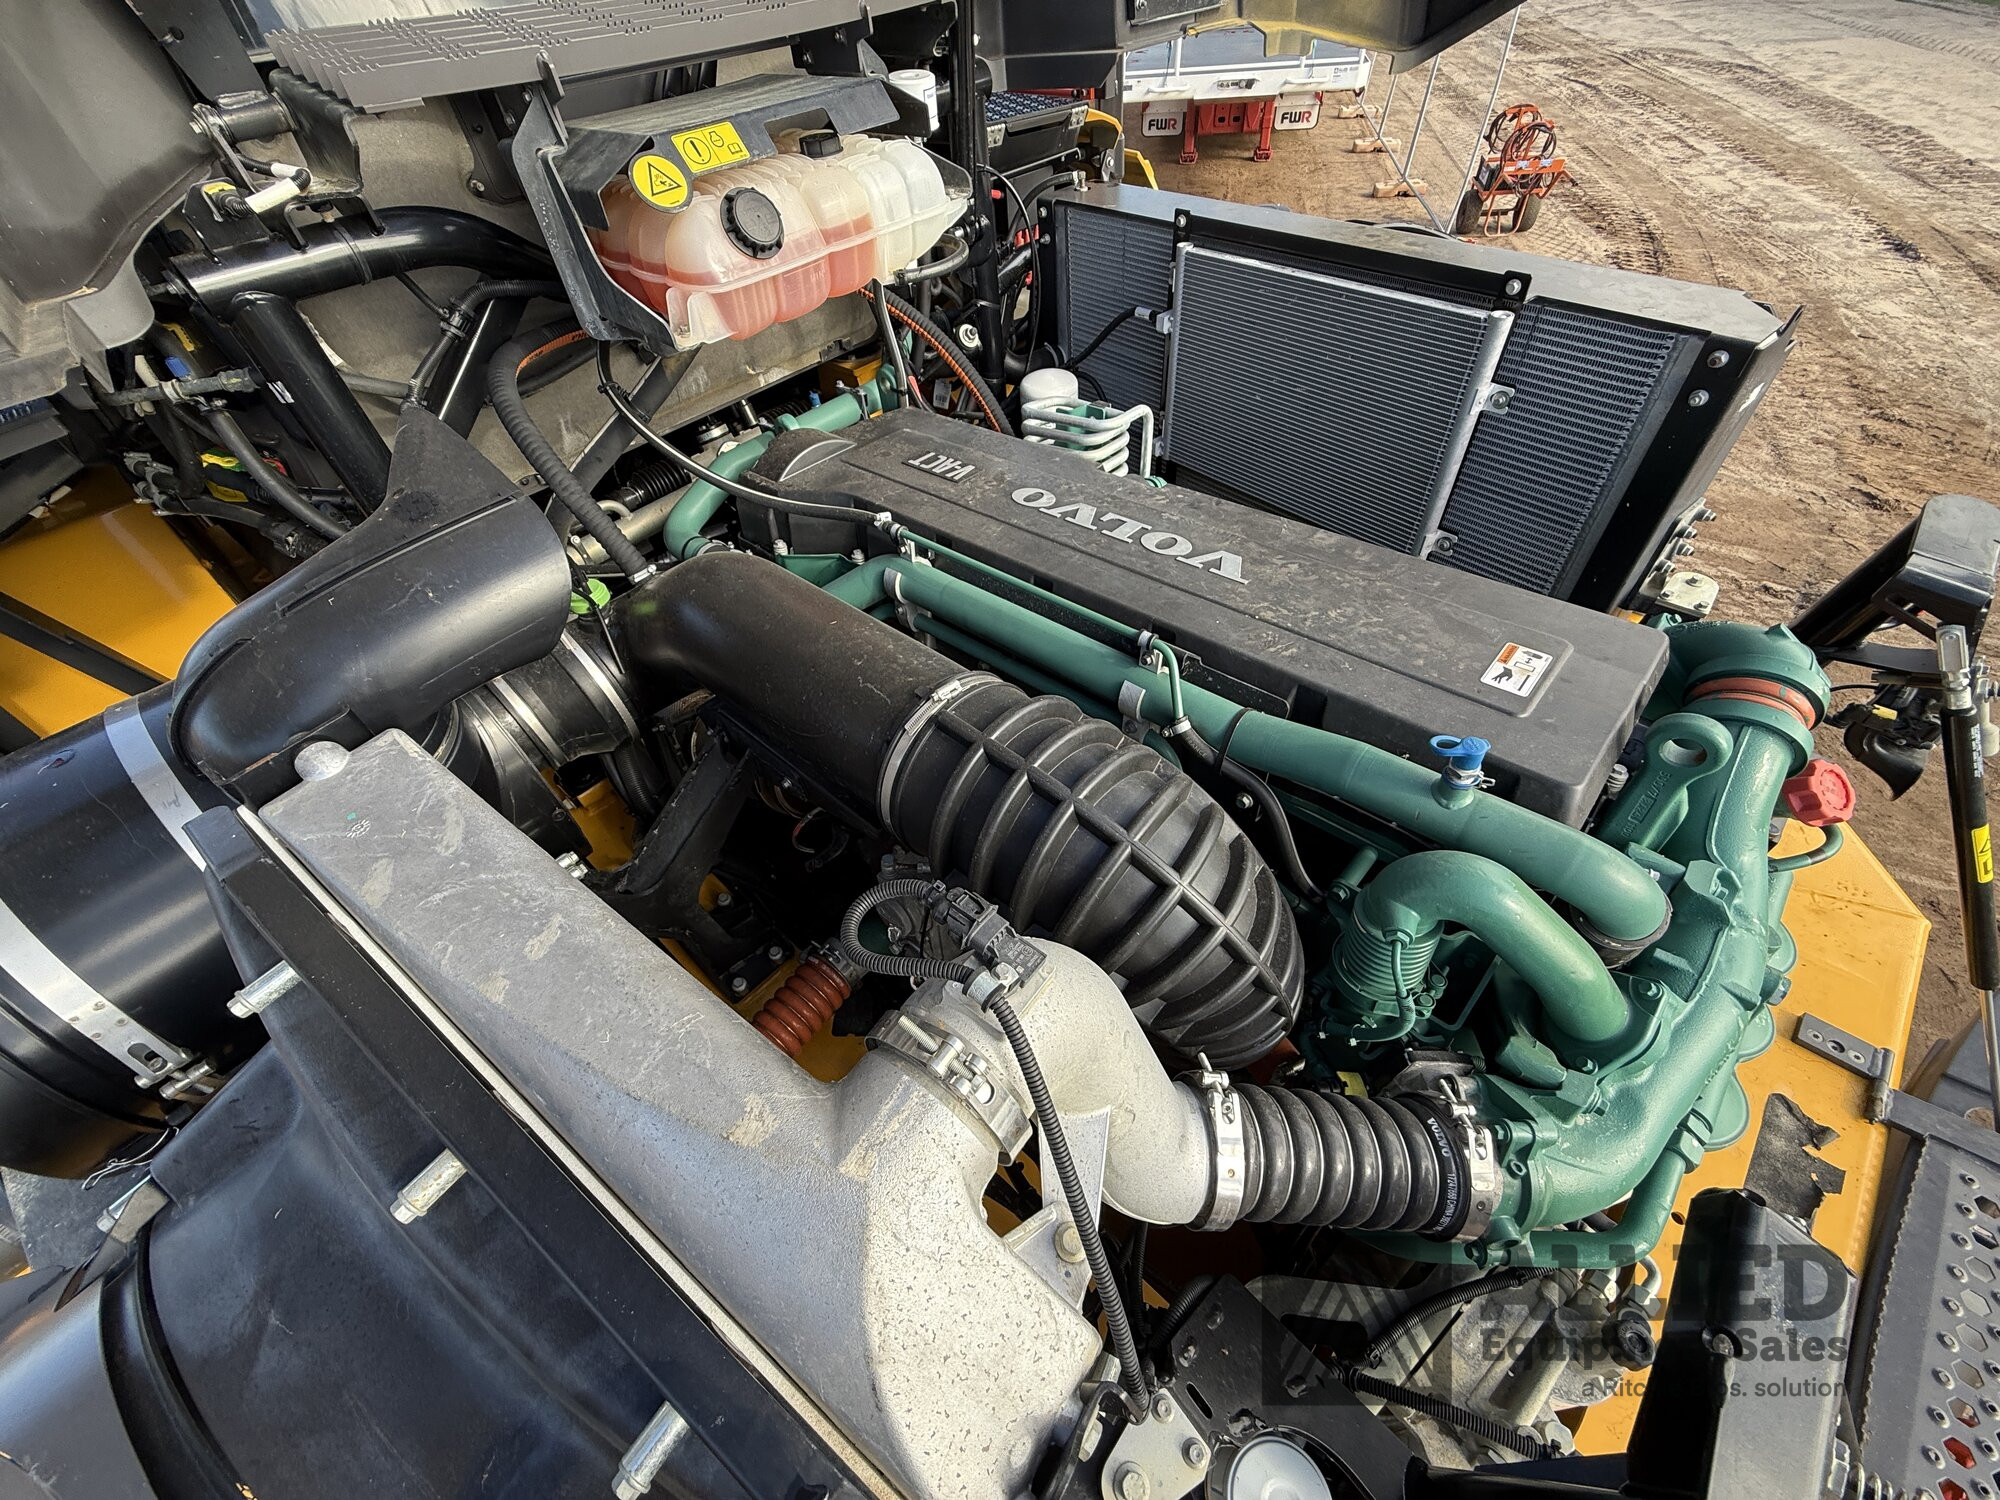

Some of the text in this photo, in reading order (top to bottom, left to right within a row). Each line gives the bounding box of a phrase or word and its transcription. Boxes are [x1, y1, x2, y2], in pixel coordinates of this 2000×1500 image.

[1148, 118, 1177, 131] FWR
[1281, 111, 1313, 124] FWR
[1011, 487, 1251, 585] VOLVO
[1427, 1117, 1452, 1157] VOLVO
